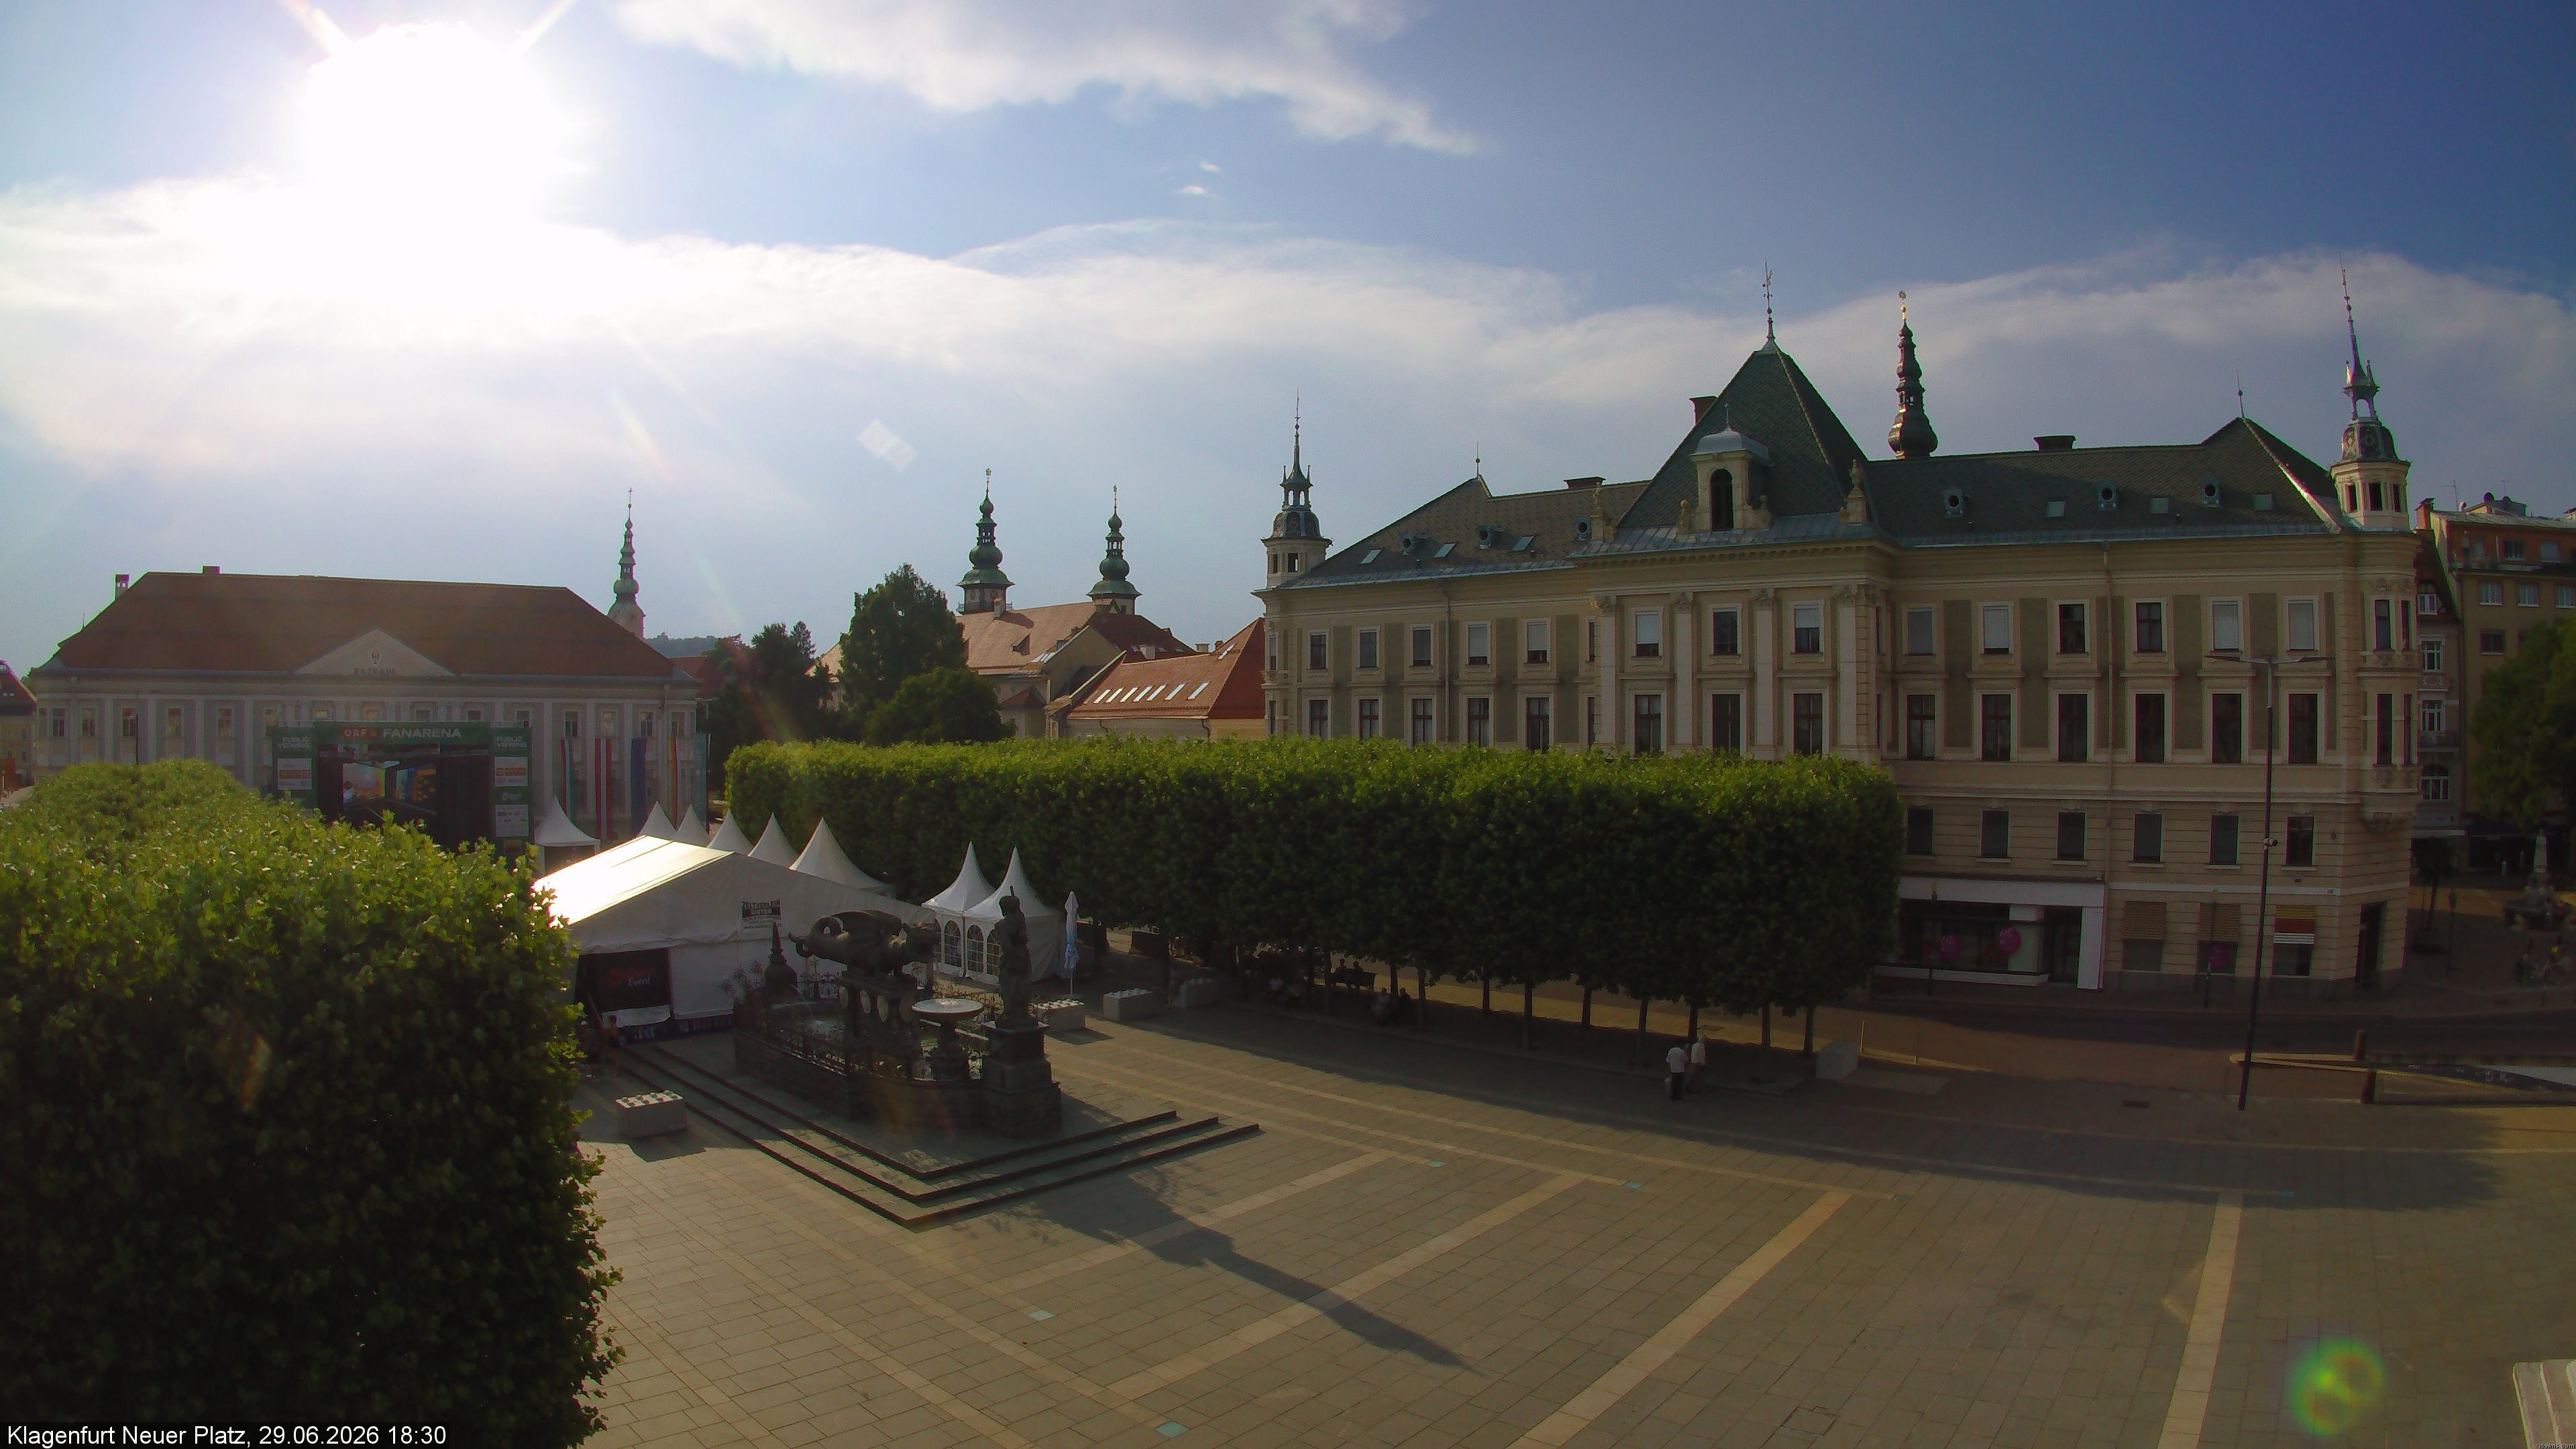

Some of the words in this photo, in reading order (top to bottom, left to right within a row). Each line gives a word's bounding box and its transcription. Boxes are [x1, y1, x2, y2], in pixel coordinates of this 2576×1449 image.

[354, 667, 397, 676] RATHAUS
[344, 729, 367, 737] ORF
[383, 729, 462, 738] FANARENA
[629, 977, 652, 987] Event
